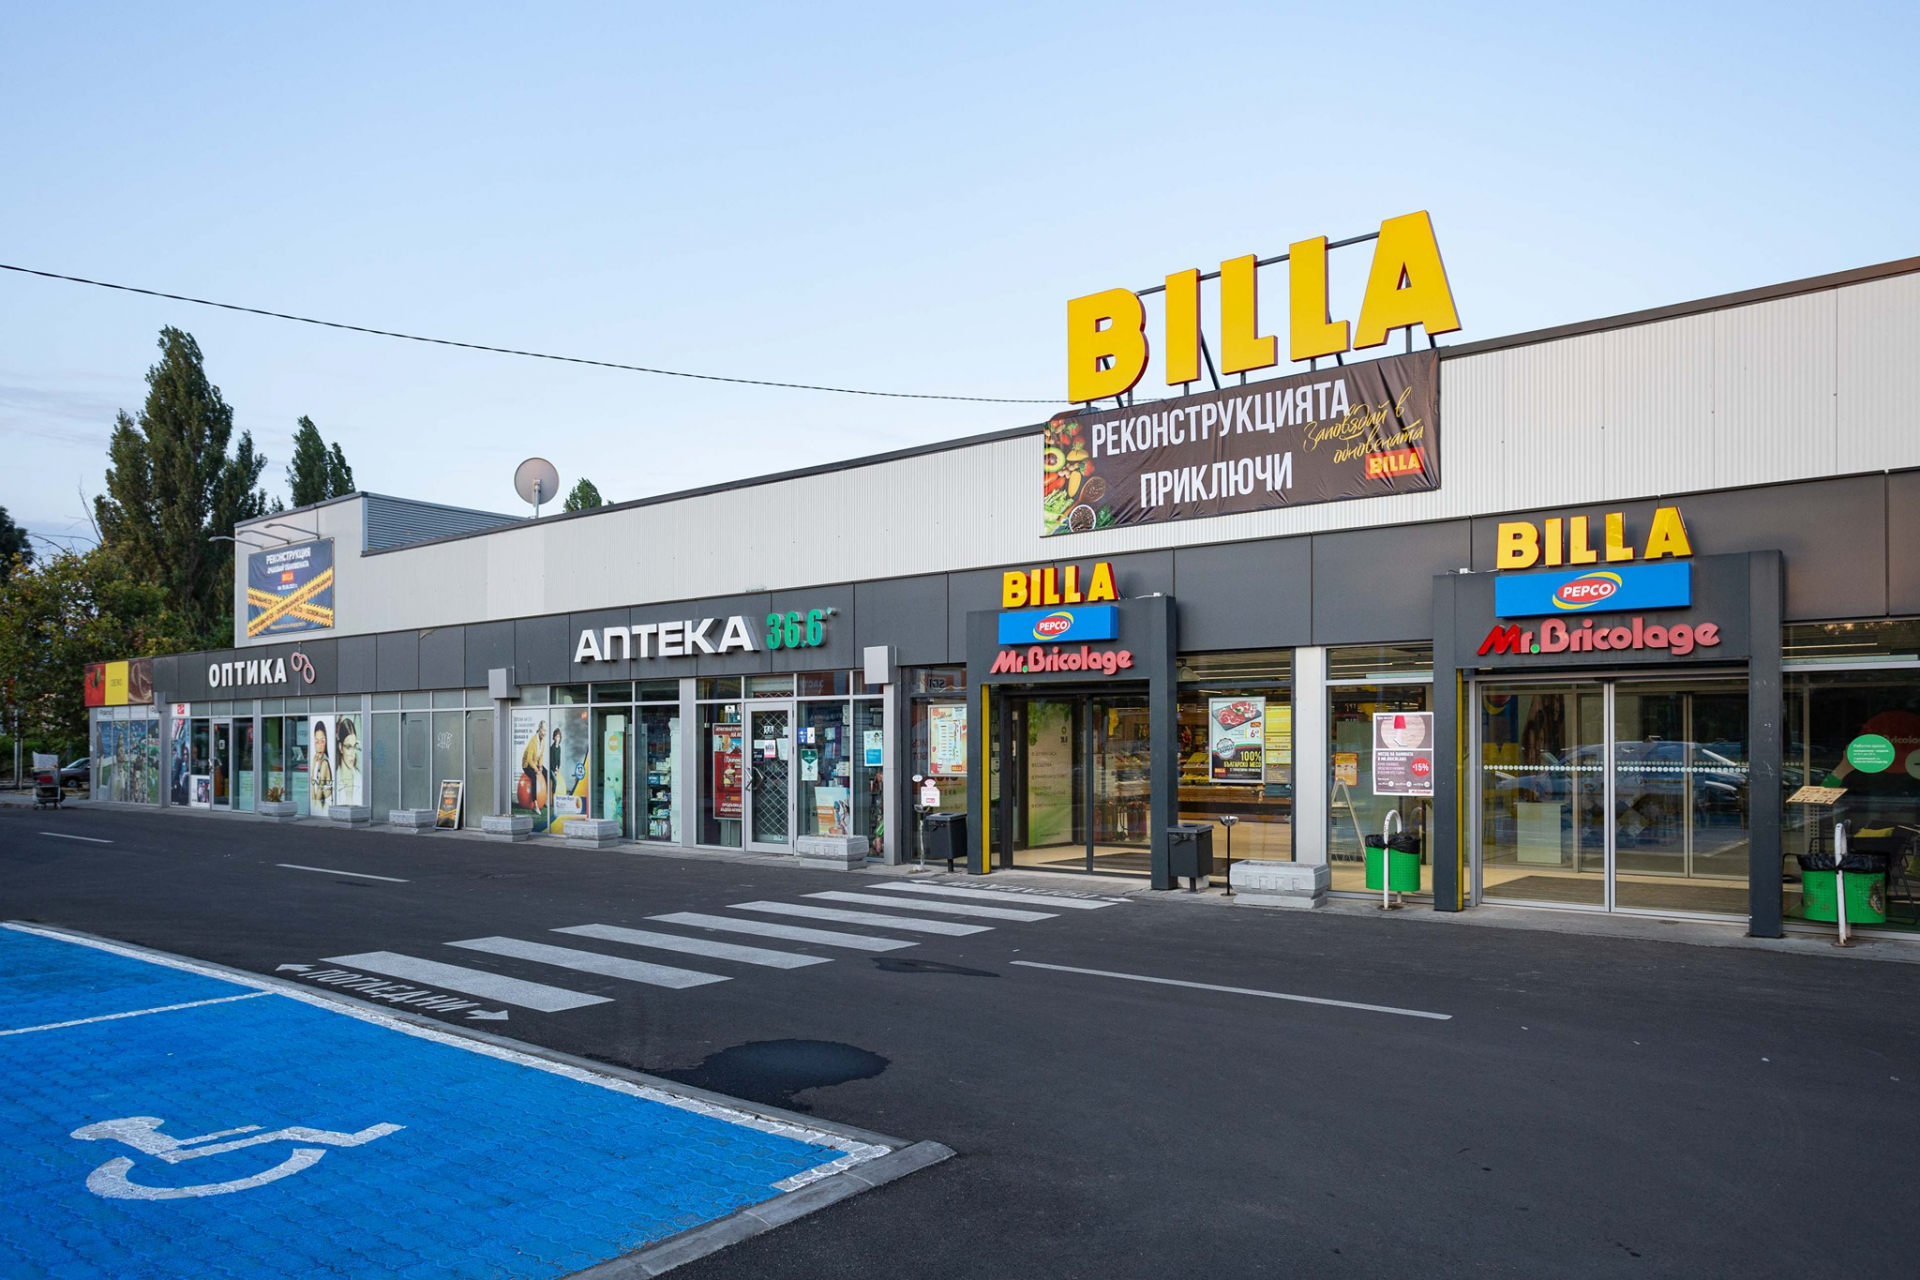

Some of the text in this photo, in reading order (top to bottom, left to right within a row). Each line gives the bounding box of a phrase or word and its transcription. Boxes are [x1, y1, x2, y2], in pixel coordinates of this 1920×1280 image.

[1067, 210, 1462, 405] BILLA
[1092, 379, 1349, 458] РЕКОНСТРУКЦИЯТА
[1140, 452, 1292, 508] ПРИКЛЮЧИ
[1369, 453, 1421, 474] BILLA
[1496, 506, 1693, 570] BILLA
[1002, 562, 1119, 608] BILLA
[1562, 582, 1613, 598] PEPCO
[574, 615, 760, 663] АПТЕКА
[1039, 620, 1068, 630] PEPCO
[208, 657, 288, 688] ОПТИКА
[1241, 751, 1262, 762] 100%
[297, 969, 481, 1012] ПОГЛЕДНИ
